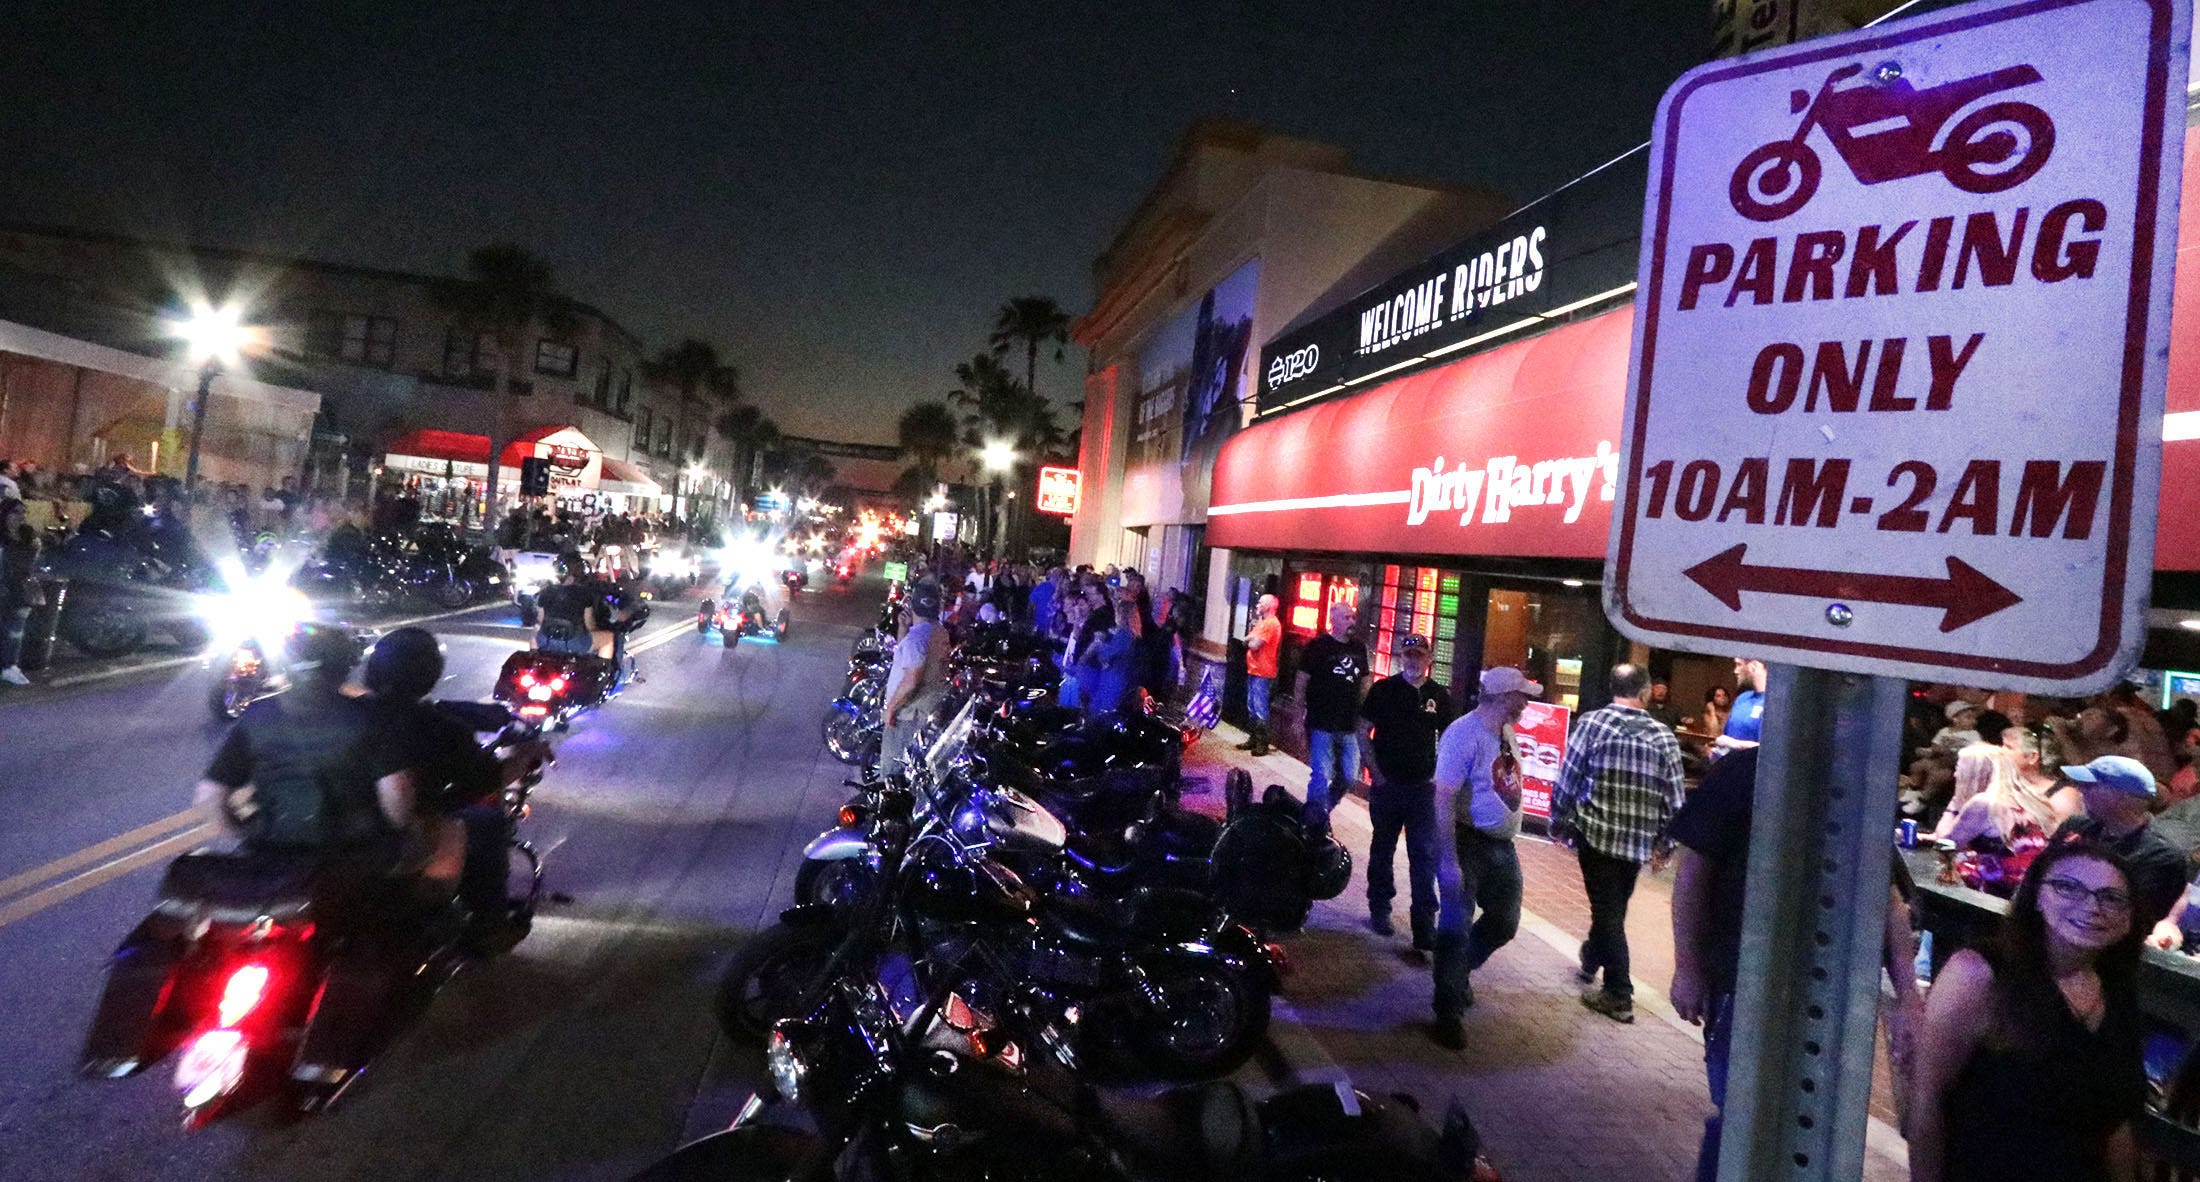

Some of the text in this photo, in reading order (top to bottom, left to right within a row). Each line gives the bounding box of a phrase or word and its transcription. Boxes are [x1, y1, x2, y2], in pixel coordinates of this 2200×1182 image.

[1360, 226, 1546, 358] WELCOME RIDERS
[1677, 198, 2107, 311] PARKING
[1746, 332, 1986, 415] ONLY
[1407, 456, 1485, 526] Dirty
[1645, 457, 2107, 540] 10AM-2AM
